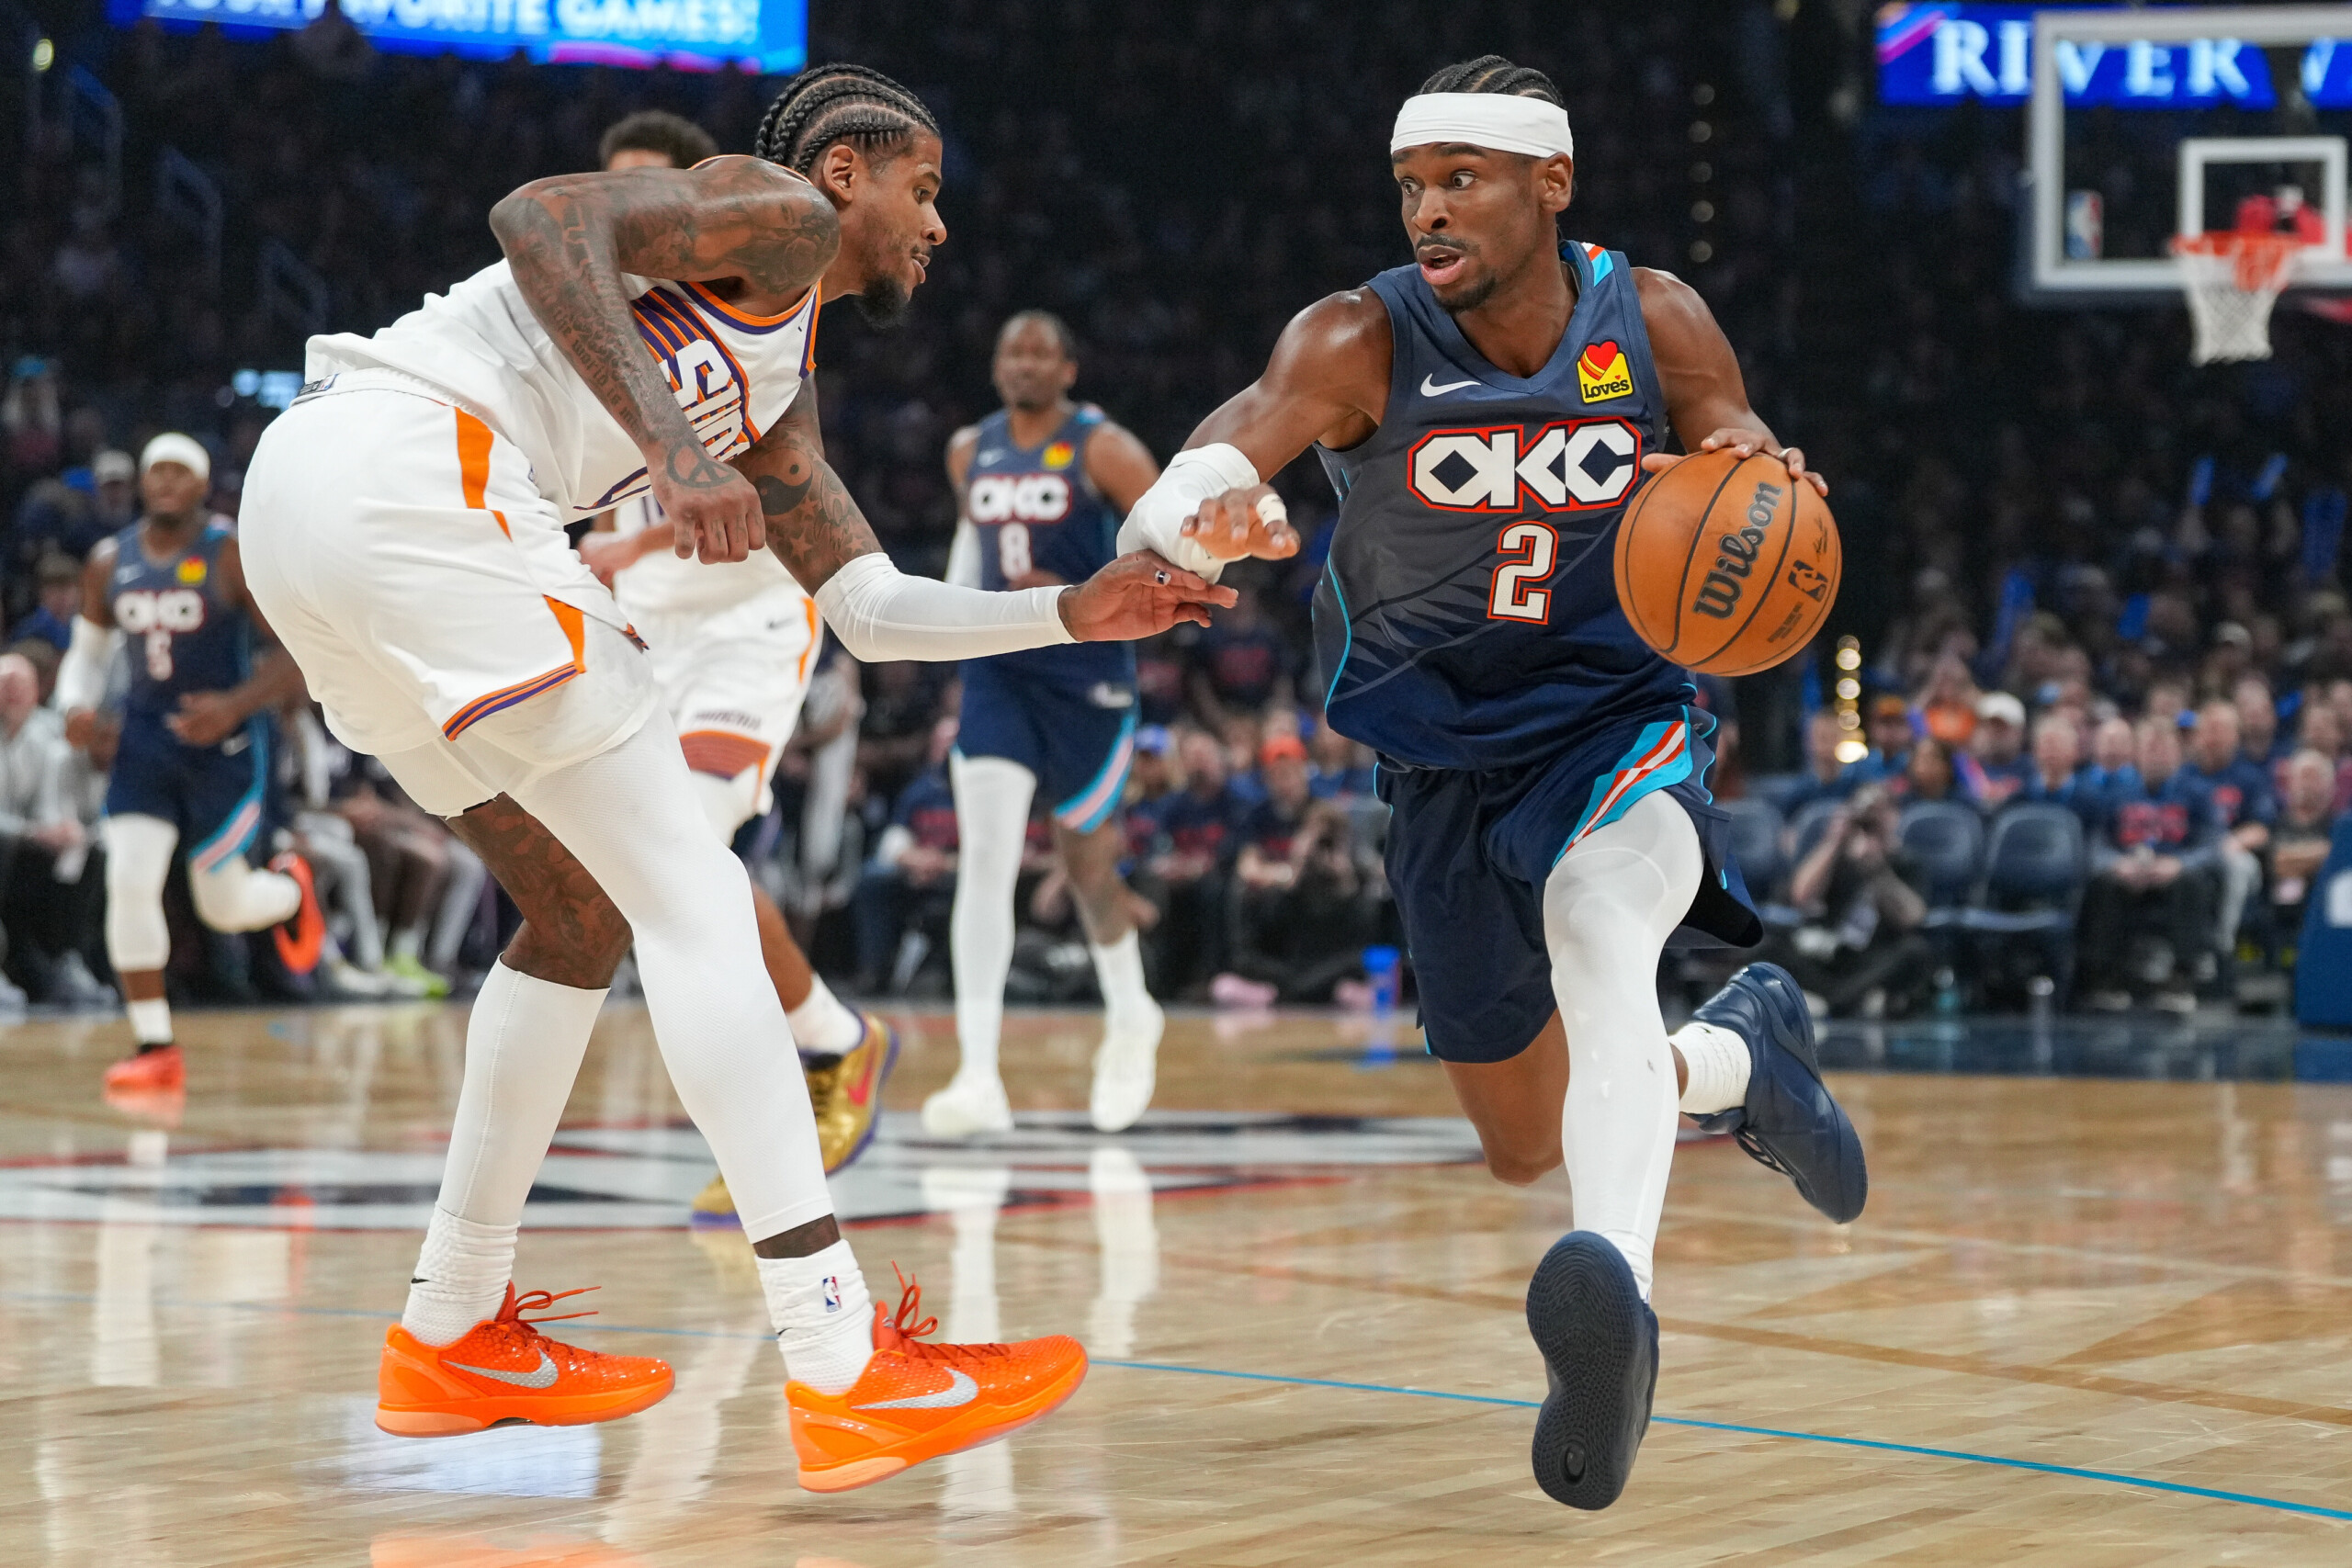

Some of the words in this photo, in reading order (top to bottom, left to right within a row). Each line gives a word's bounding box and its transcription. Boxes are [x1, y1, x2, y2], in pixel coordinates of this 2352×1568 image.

[1408, 417, 1641, 512] OKC
[1487, 521, 1559, 625] 2
[1692, 481, 1782, 620] Wilson
